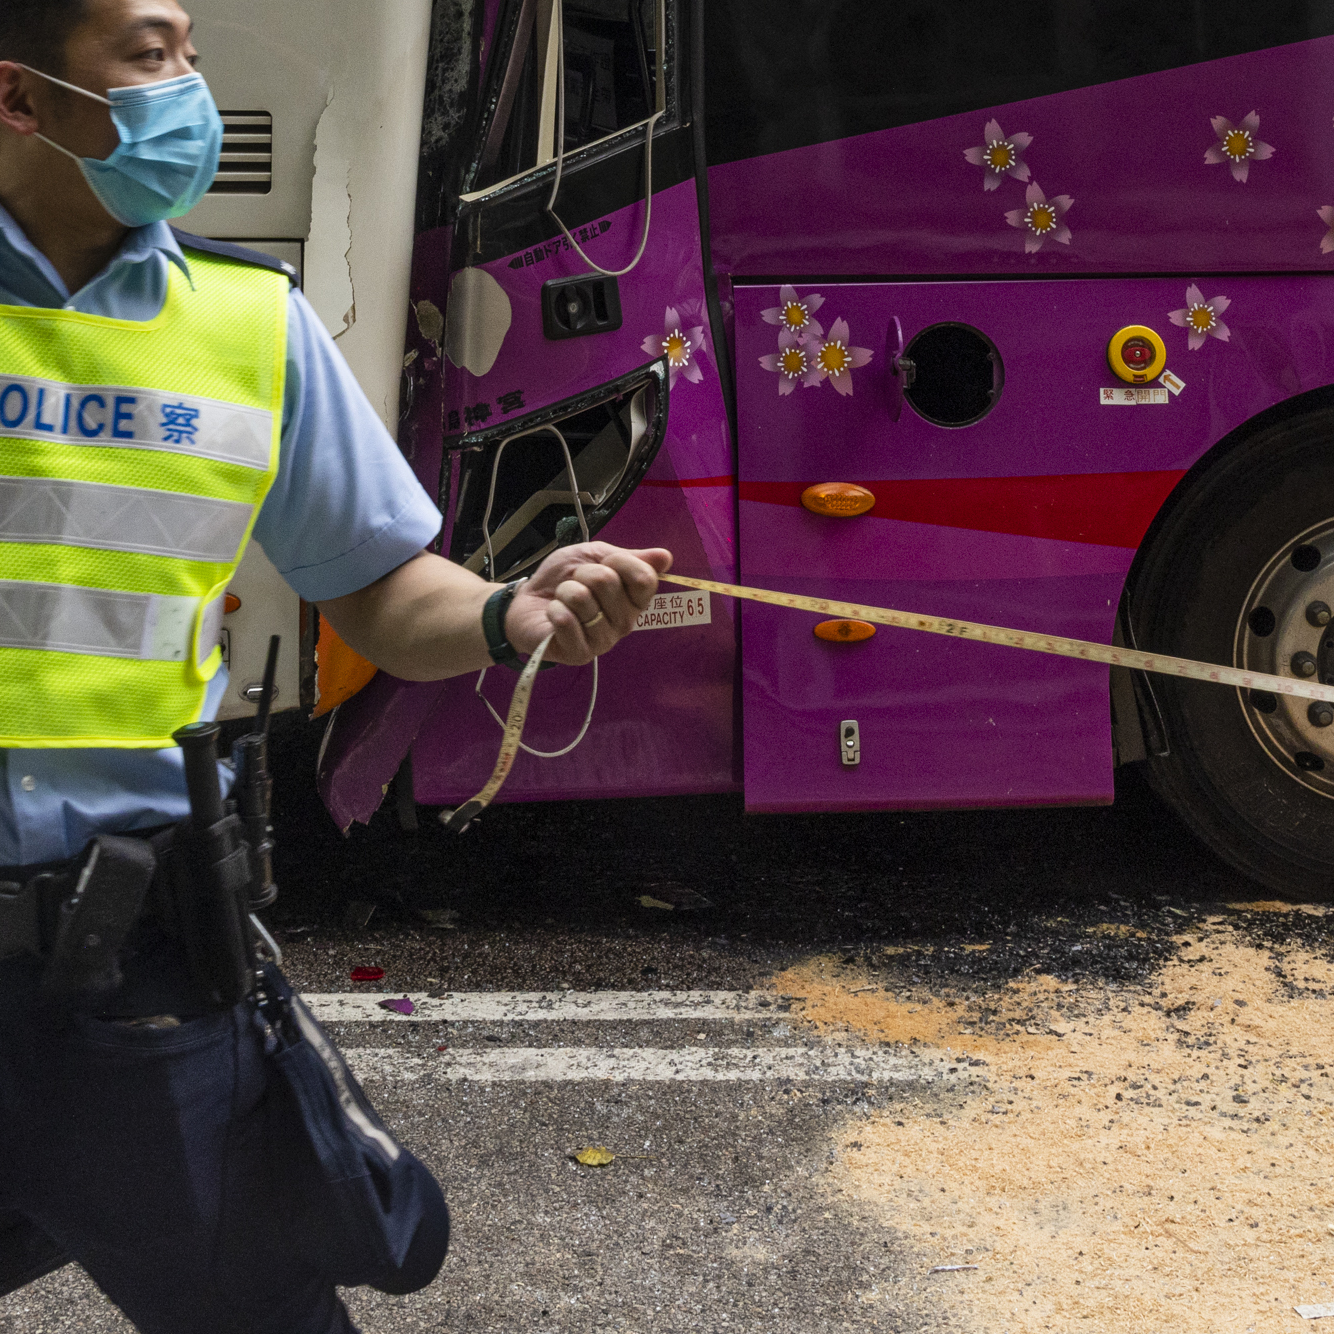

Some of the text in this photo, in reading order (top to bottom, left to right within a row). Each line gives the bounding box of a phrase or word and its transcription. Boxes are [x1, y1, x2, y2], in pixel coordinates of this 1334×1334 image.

[158, 401, 201, 446] 察
[687, 597, 705, 617] 65
[636, 610, 685, 627] CAPACITY
